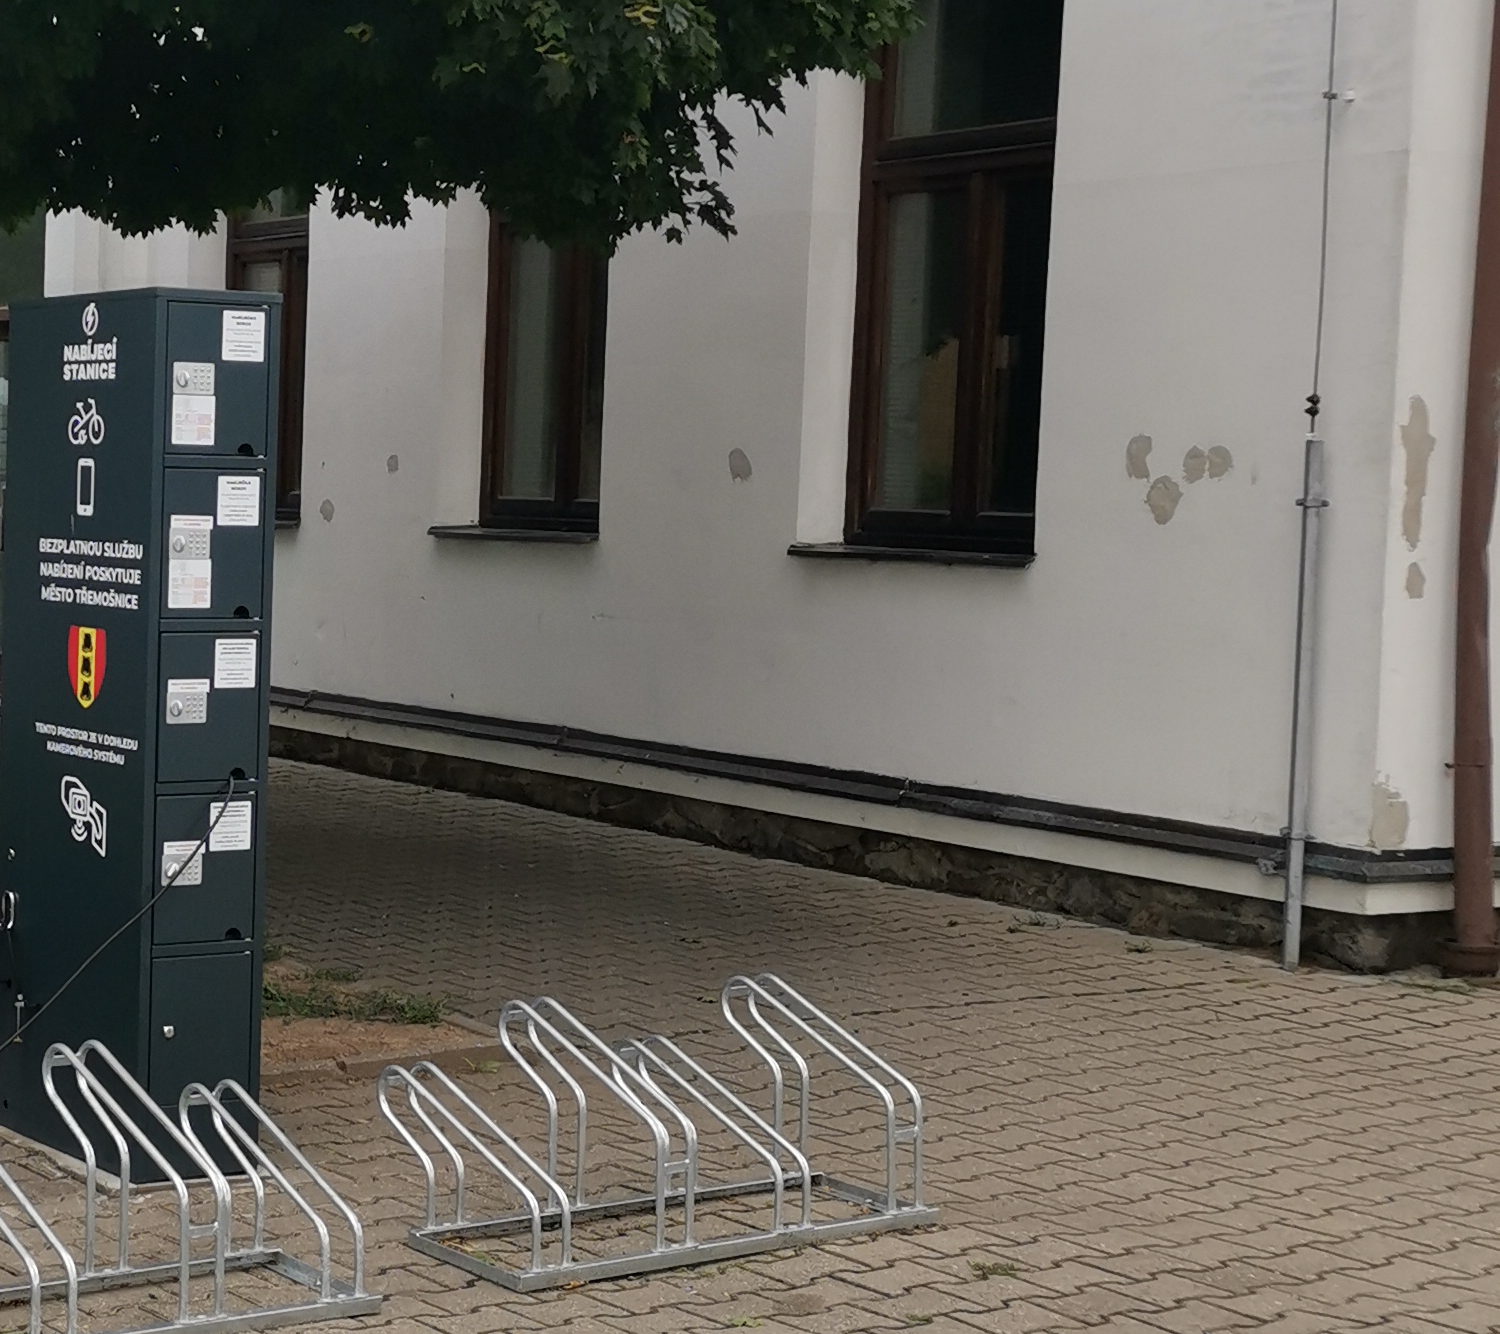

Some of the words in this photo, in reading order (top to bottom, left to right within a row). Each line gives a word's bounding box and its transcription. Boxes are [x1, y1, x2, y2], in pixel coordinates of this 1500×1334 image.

[63, 336, 117, 361] NABÍJECÍ
[63, 362, 116, 380] STANICE
[39, 537, 103, 557] BEZPLATNOU
[103, 540, 143, 560] SLUŽBU
[40, 559, 85, 580] NABÍJENÍ
[85, 565, 142, 585] POSKYTUJE
[41, 583, 74, 602] MĚSTO
[75, 586, 139, 610] TŘEMOŠNICE
